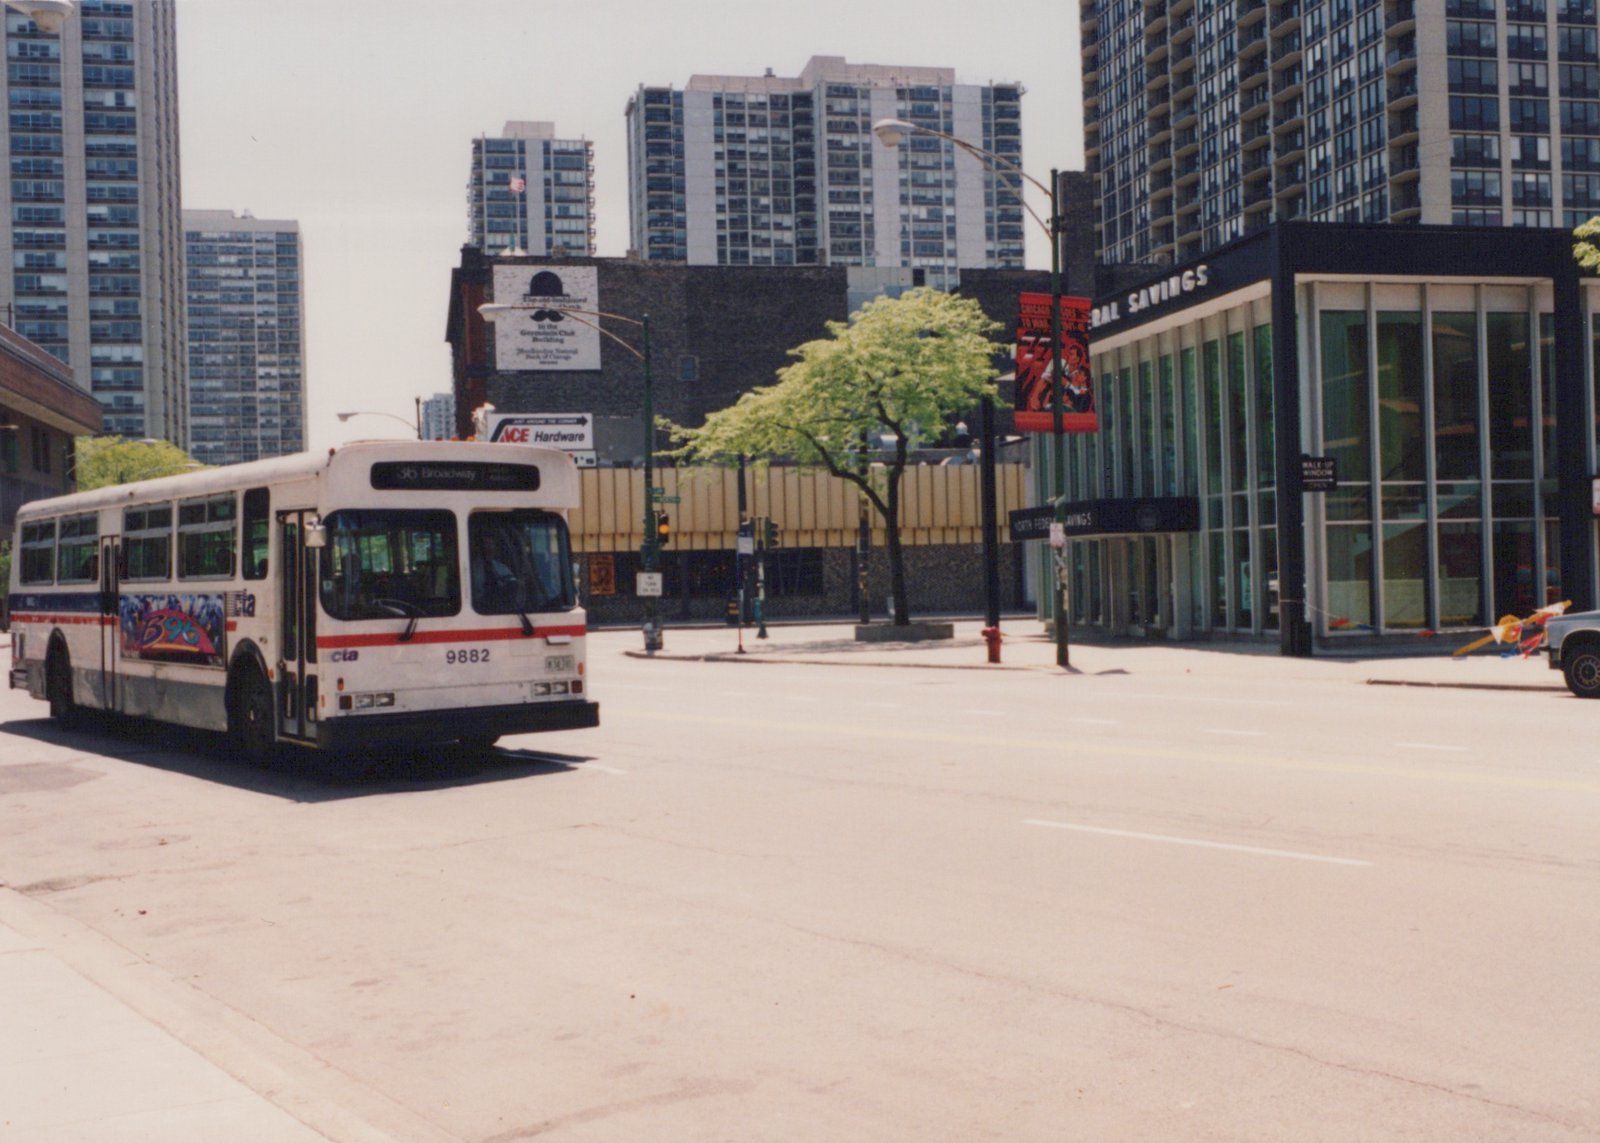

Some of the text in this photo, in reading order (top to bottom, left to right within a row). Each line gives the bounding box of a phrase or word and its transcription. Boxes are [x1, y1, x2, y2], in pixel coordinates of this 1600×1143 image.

[1127, 264, 1208, 313] SAVINGS
[500, 427, 585, 443] ACE Hardware
[1302, 461, 1334, 469] WALK-UP
[421, 467, 476, 481] Broadway
[141, 614, 200, 648] B96
[330, 649, 360, 663] cta
[446, 648, 491, 665] 9882
